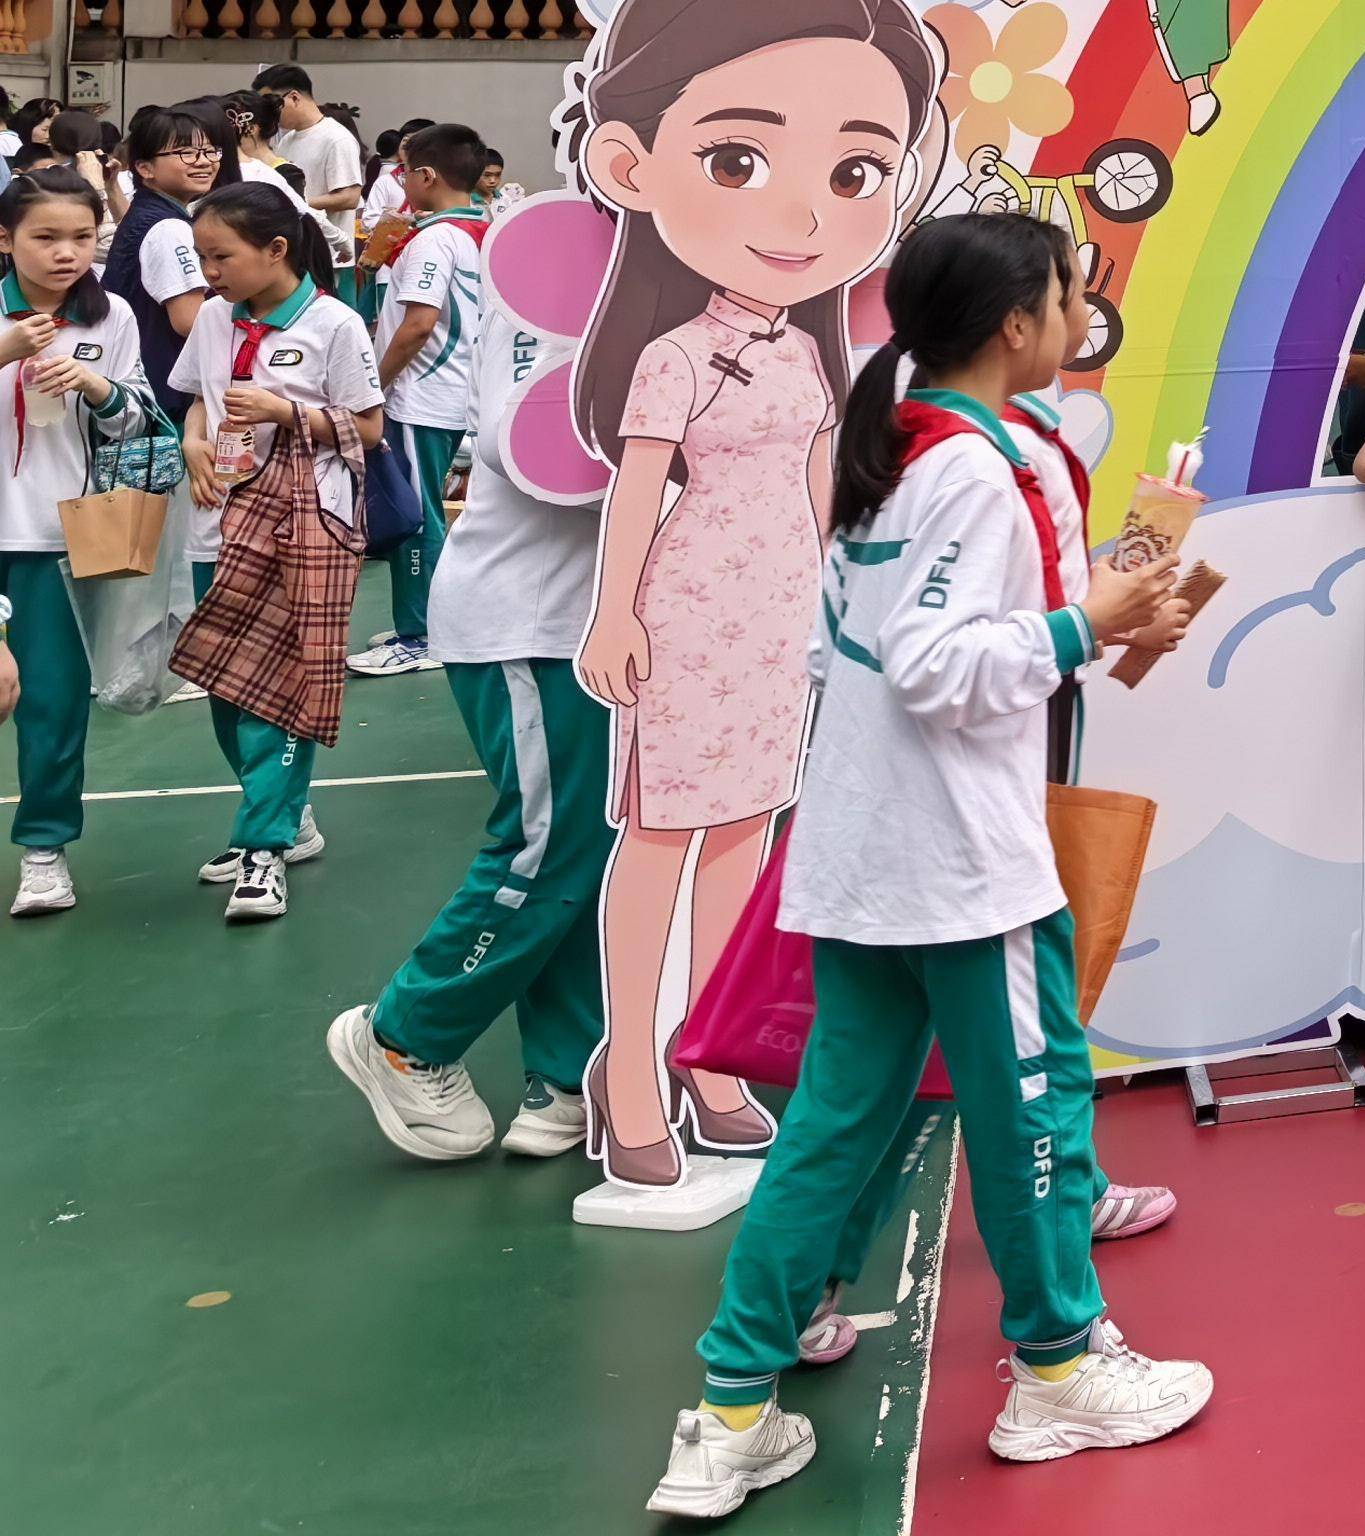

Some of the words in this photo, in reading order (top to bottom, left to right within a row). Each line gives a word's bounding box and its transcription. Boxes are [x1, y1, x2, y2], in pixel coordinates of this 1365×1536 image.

[174, 245, 197, 276] DFD
[418, 261, 438, 291] DFD
[410, 548, 420, 576] DFD
[462, 930, 496, 974] DFD
[1032, 1135, 1053, 1200] DFD
